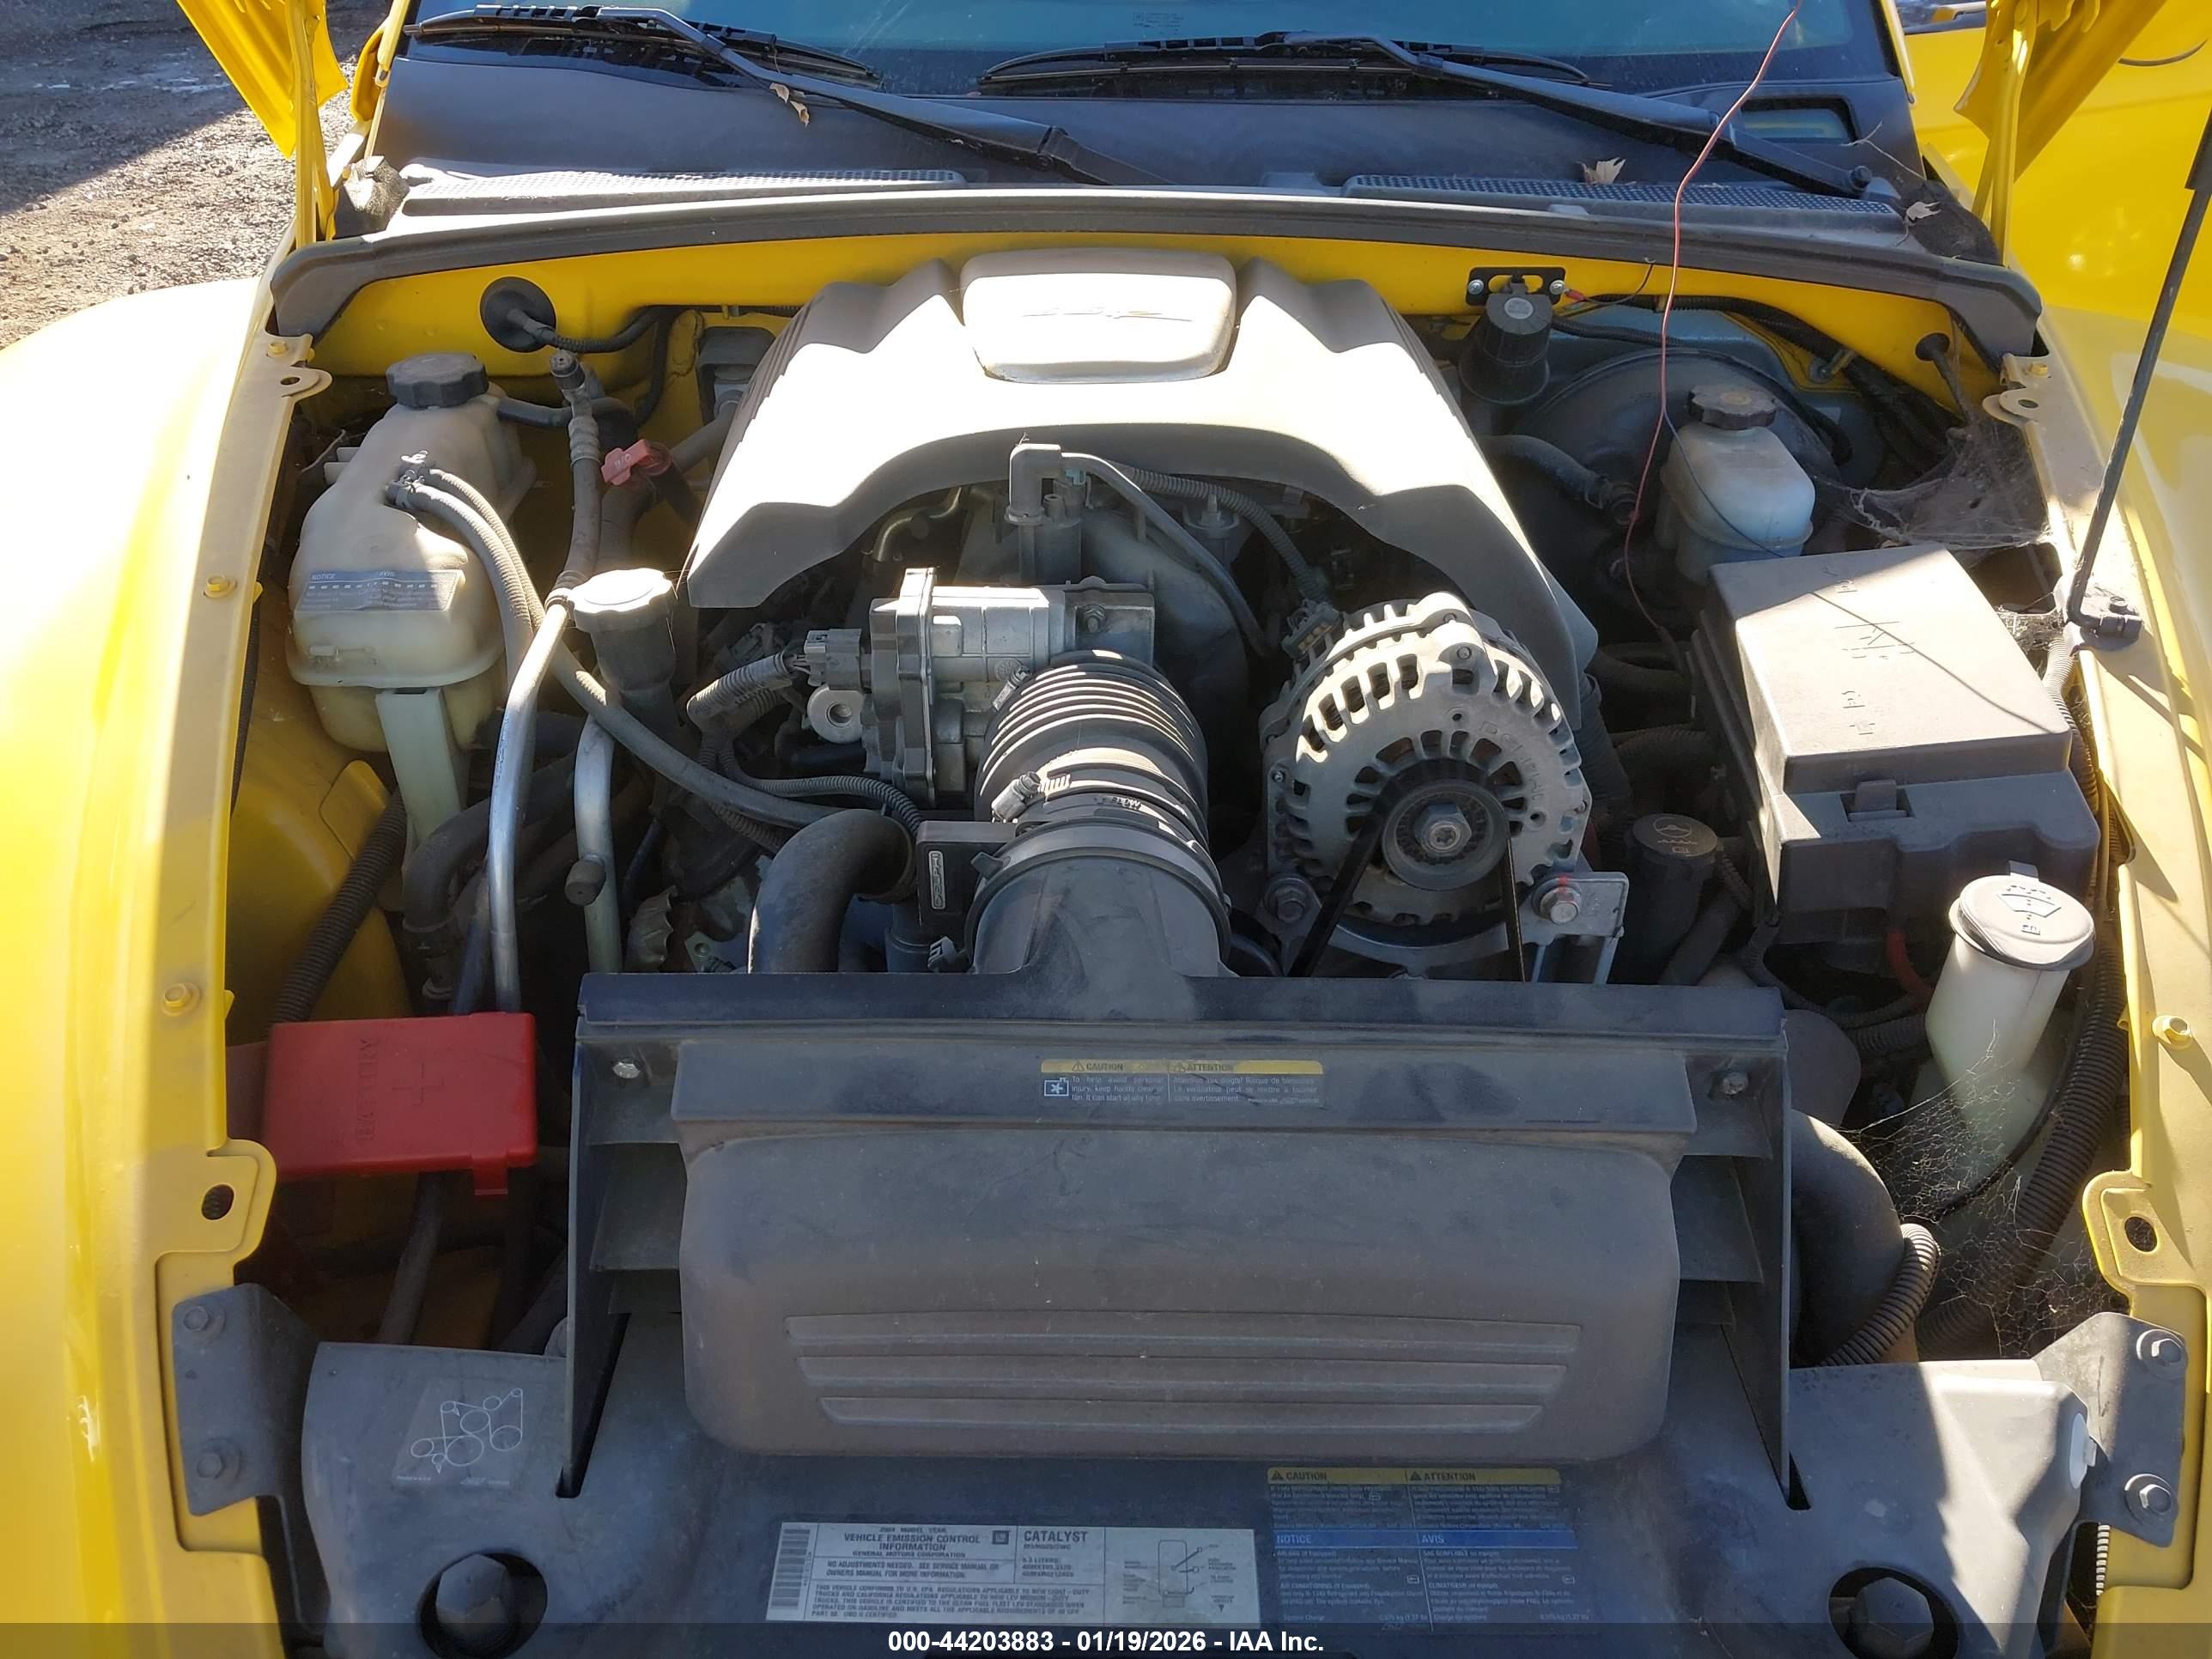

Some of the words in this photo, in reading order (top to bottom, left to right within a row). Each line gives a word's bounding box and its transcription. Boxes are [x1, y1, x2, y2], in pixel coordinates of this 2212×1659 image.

[1285, 1472, 1327, 1481] CAUTION
[1424, 1472, 1476, 1481] ATTENTION
[844, 1533, 884, 1541] VEHICLE
[887, 1534, 933, 1542] EMISSION
[936, 1534, 981, 1543] CONTROL
[1024, 1530, 1088, 1542] CATALYST
[1277, 1534, 1312, 1544] NOTICE
[1421, 1534, 1444, 1544] AVIS
